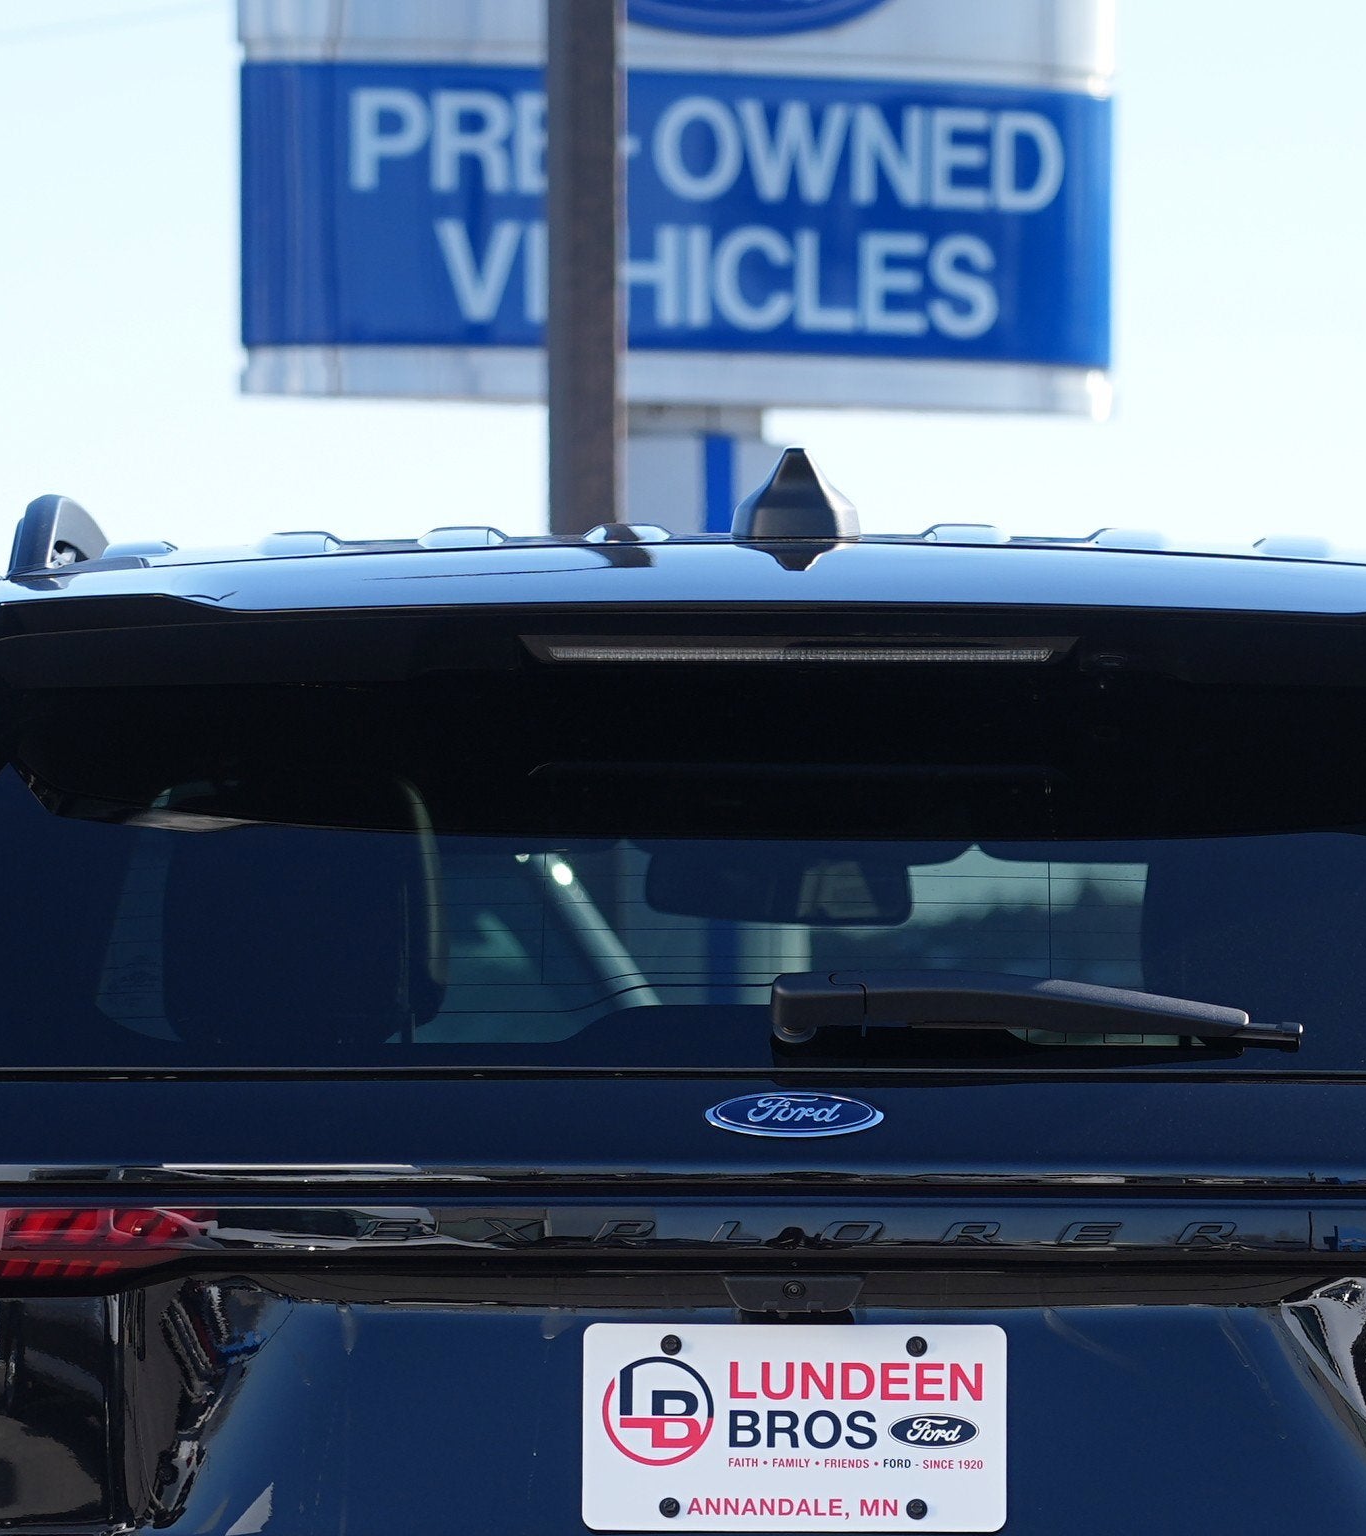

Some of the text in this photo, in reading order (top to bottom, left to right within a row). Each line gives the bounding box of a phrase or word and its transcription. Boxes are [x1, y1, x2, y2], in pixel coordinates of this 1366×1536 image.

[349, 86, 1065, 211] PREOWNED
[747, 1096, 842, 1123] Ford
[357, 1216, 1238, 1246] EXPLORER
[729, 1361, 984, 1402] LUNDEEN
[728, 1410, 878, 1450] BROS
[905, 1416, 962, 1443] Ford
[728, 1457, 984, 1470] FAITH FAMILY FRIENDS FORD SINCE 1920
[686, 1497, 899, 1520] ANNANDALE, MN
